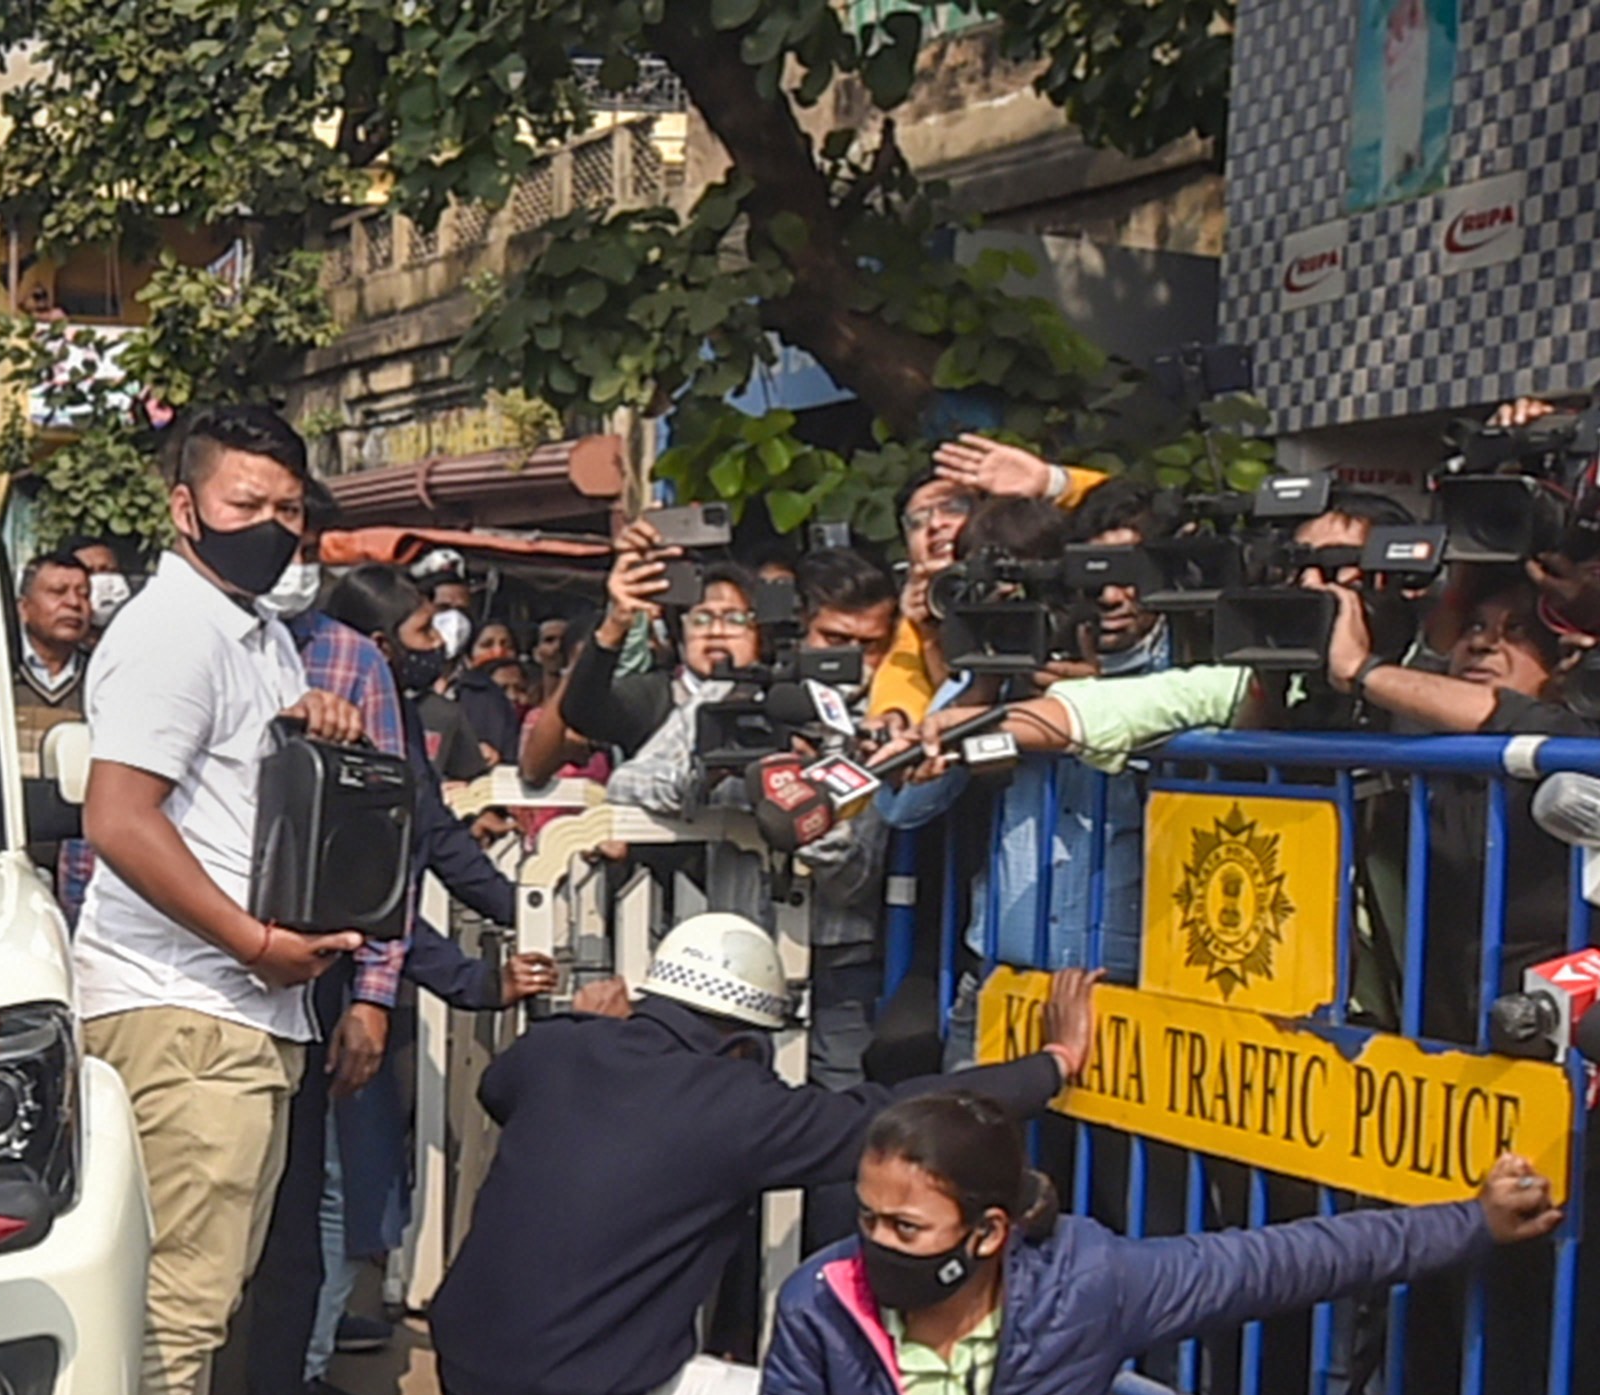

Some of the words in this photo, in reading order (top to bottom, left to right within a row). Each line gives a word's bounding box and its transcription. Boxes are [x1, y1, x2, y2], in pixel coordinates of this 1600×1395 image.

[1462, 204, 1516, 234] RUPA
[1004, 993, 1146, 1105] KOATA
[1163, 1026, 1329, 1149] TRAFFIC
